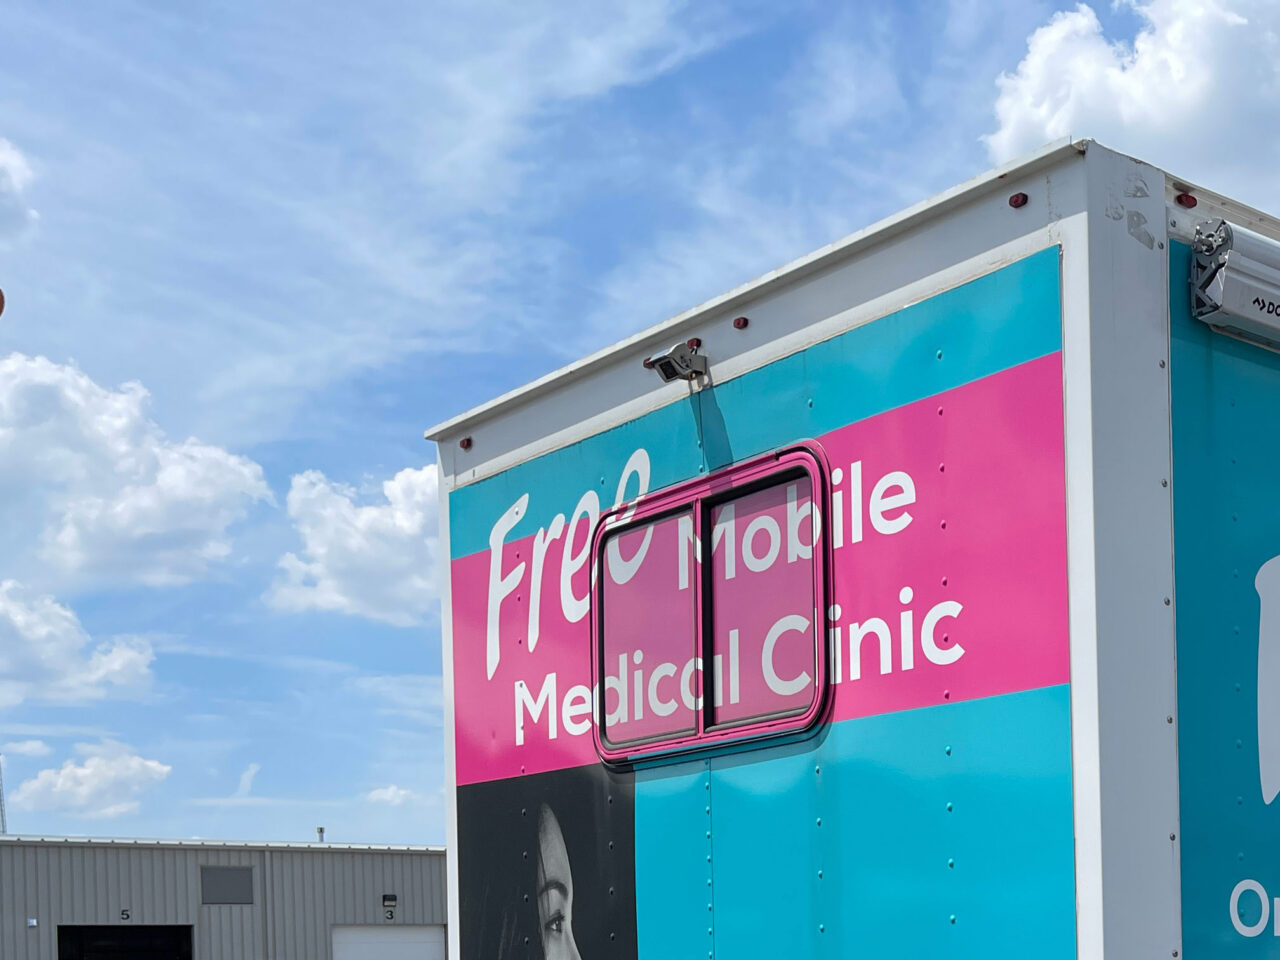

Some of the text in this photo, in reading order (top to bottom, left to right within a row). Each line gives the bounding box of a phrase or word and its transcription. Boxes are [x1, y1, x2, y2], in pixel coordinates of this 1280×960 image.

[486, 448, 916, 681] Free Mobile
[514, 628, 741, 746] Medical
[121, 909, 131, 921] 5
[385, 910, 395, 921] 3
